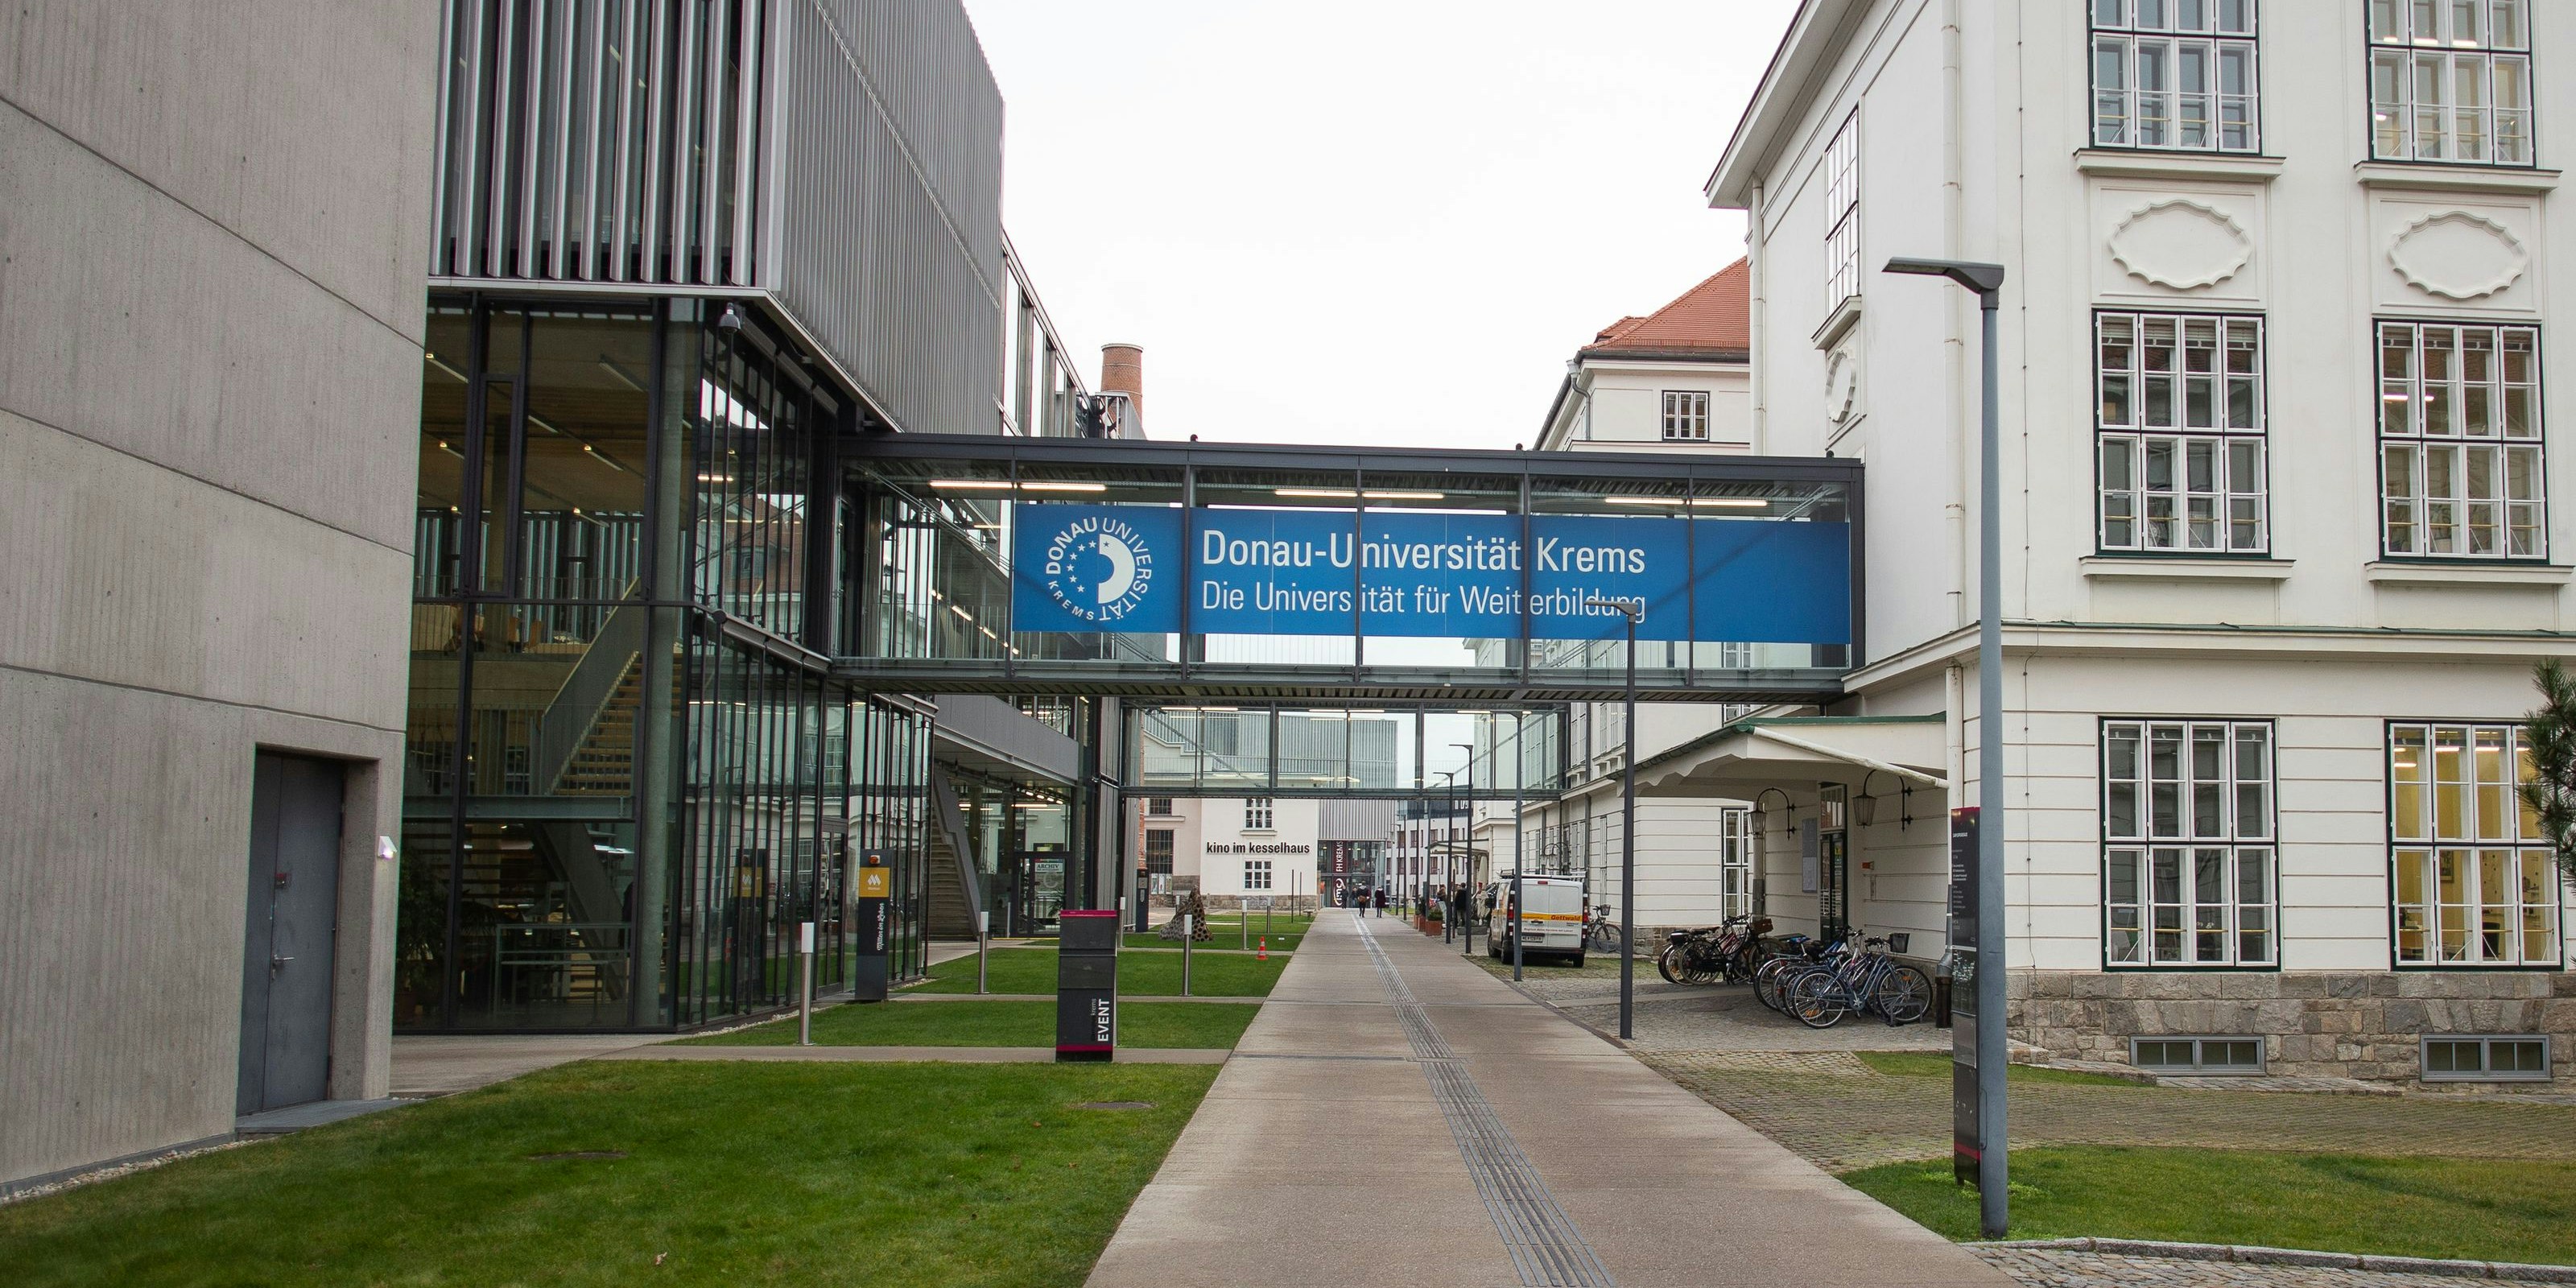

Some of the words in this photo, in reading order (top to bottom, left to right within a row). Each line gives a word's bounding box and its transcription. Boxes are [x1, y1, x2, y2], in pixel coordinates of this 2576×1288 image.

[1046, 517, 1098, 575] DONAU
[1099, 517, 1153, 621] UNIVERSITÄT
[1203, 529, 1521, 571] Donau-Universität
[1538, 536, 1645, 573] Krems
[1048, 580, 1095, 621] KREMS
[1203, 580, 1245, 610] Die
[1256, 581, 1405, 613] Universität
[1414, 584, 1451, 613] für
[1206, 841, 1230, 853] kino
[1232, 841, 1246, 853] im
[1249, 841, 1311, 853] kesselhaus
[1335, 840, 1344, 862] KREMS
[1335, 863, 1344, 872] FH
[1097, 998, 1110, 1042] EVENT
